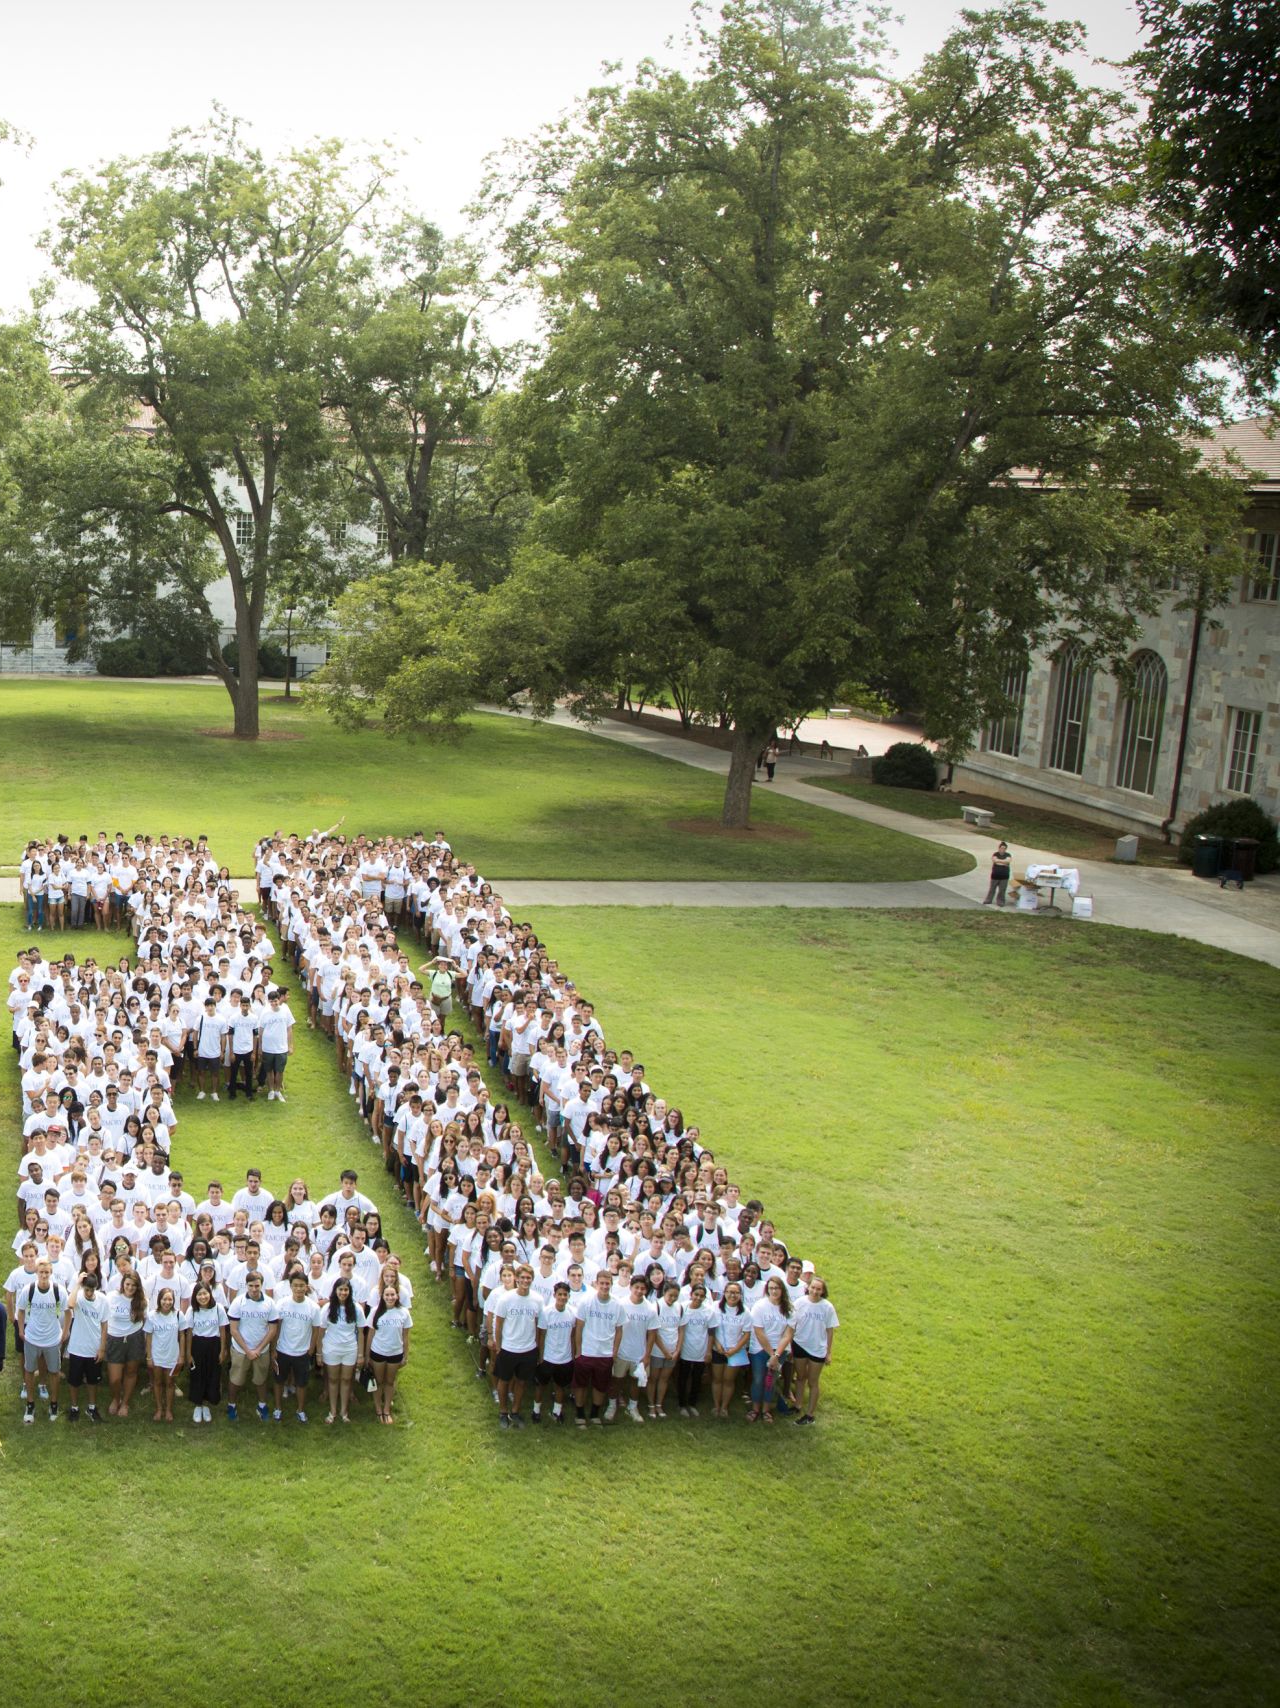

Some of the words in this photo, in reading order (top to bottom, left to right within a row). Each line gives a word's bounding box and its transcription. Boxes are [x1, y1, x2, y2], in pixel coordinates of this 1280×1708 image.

[241, 1311, 268, 1319] EMORY
[284, 1312, 311, 1321] EMORY
[590, 1310, 614, 1320] EMORY
